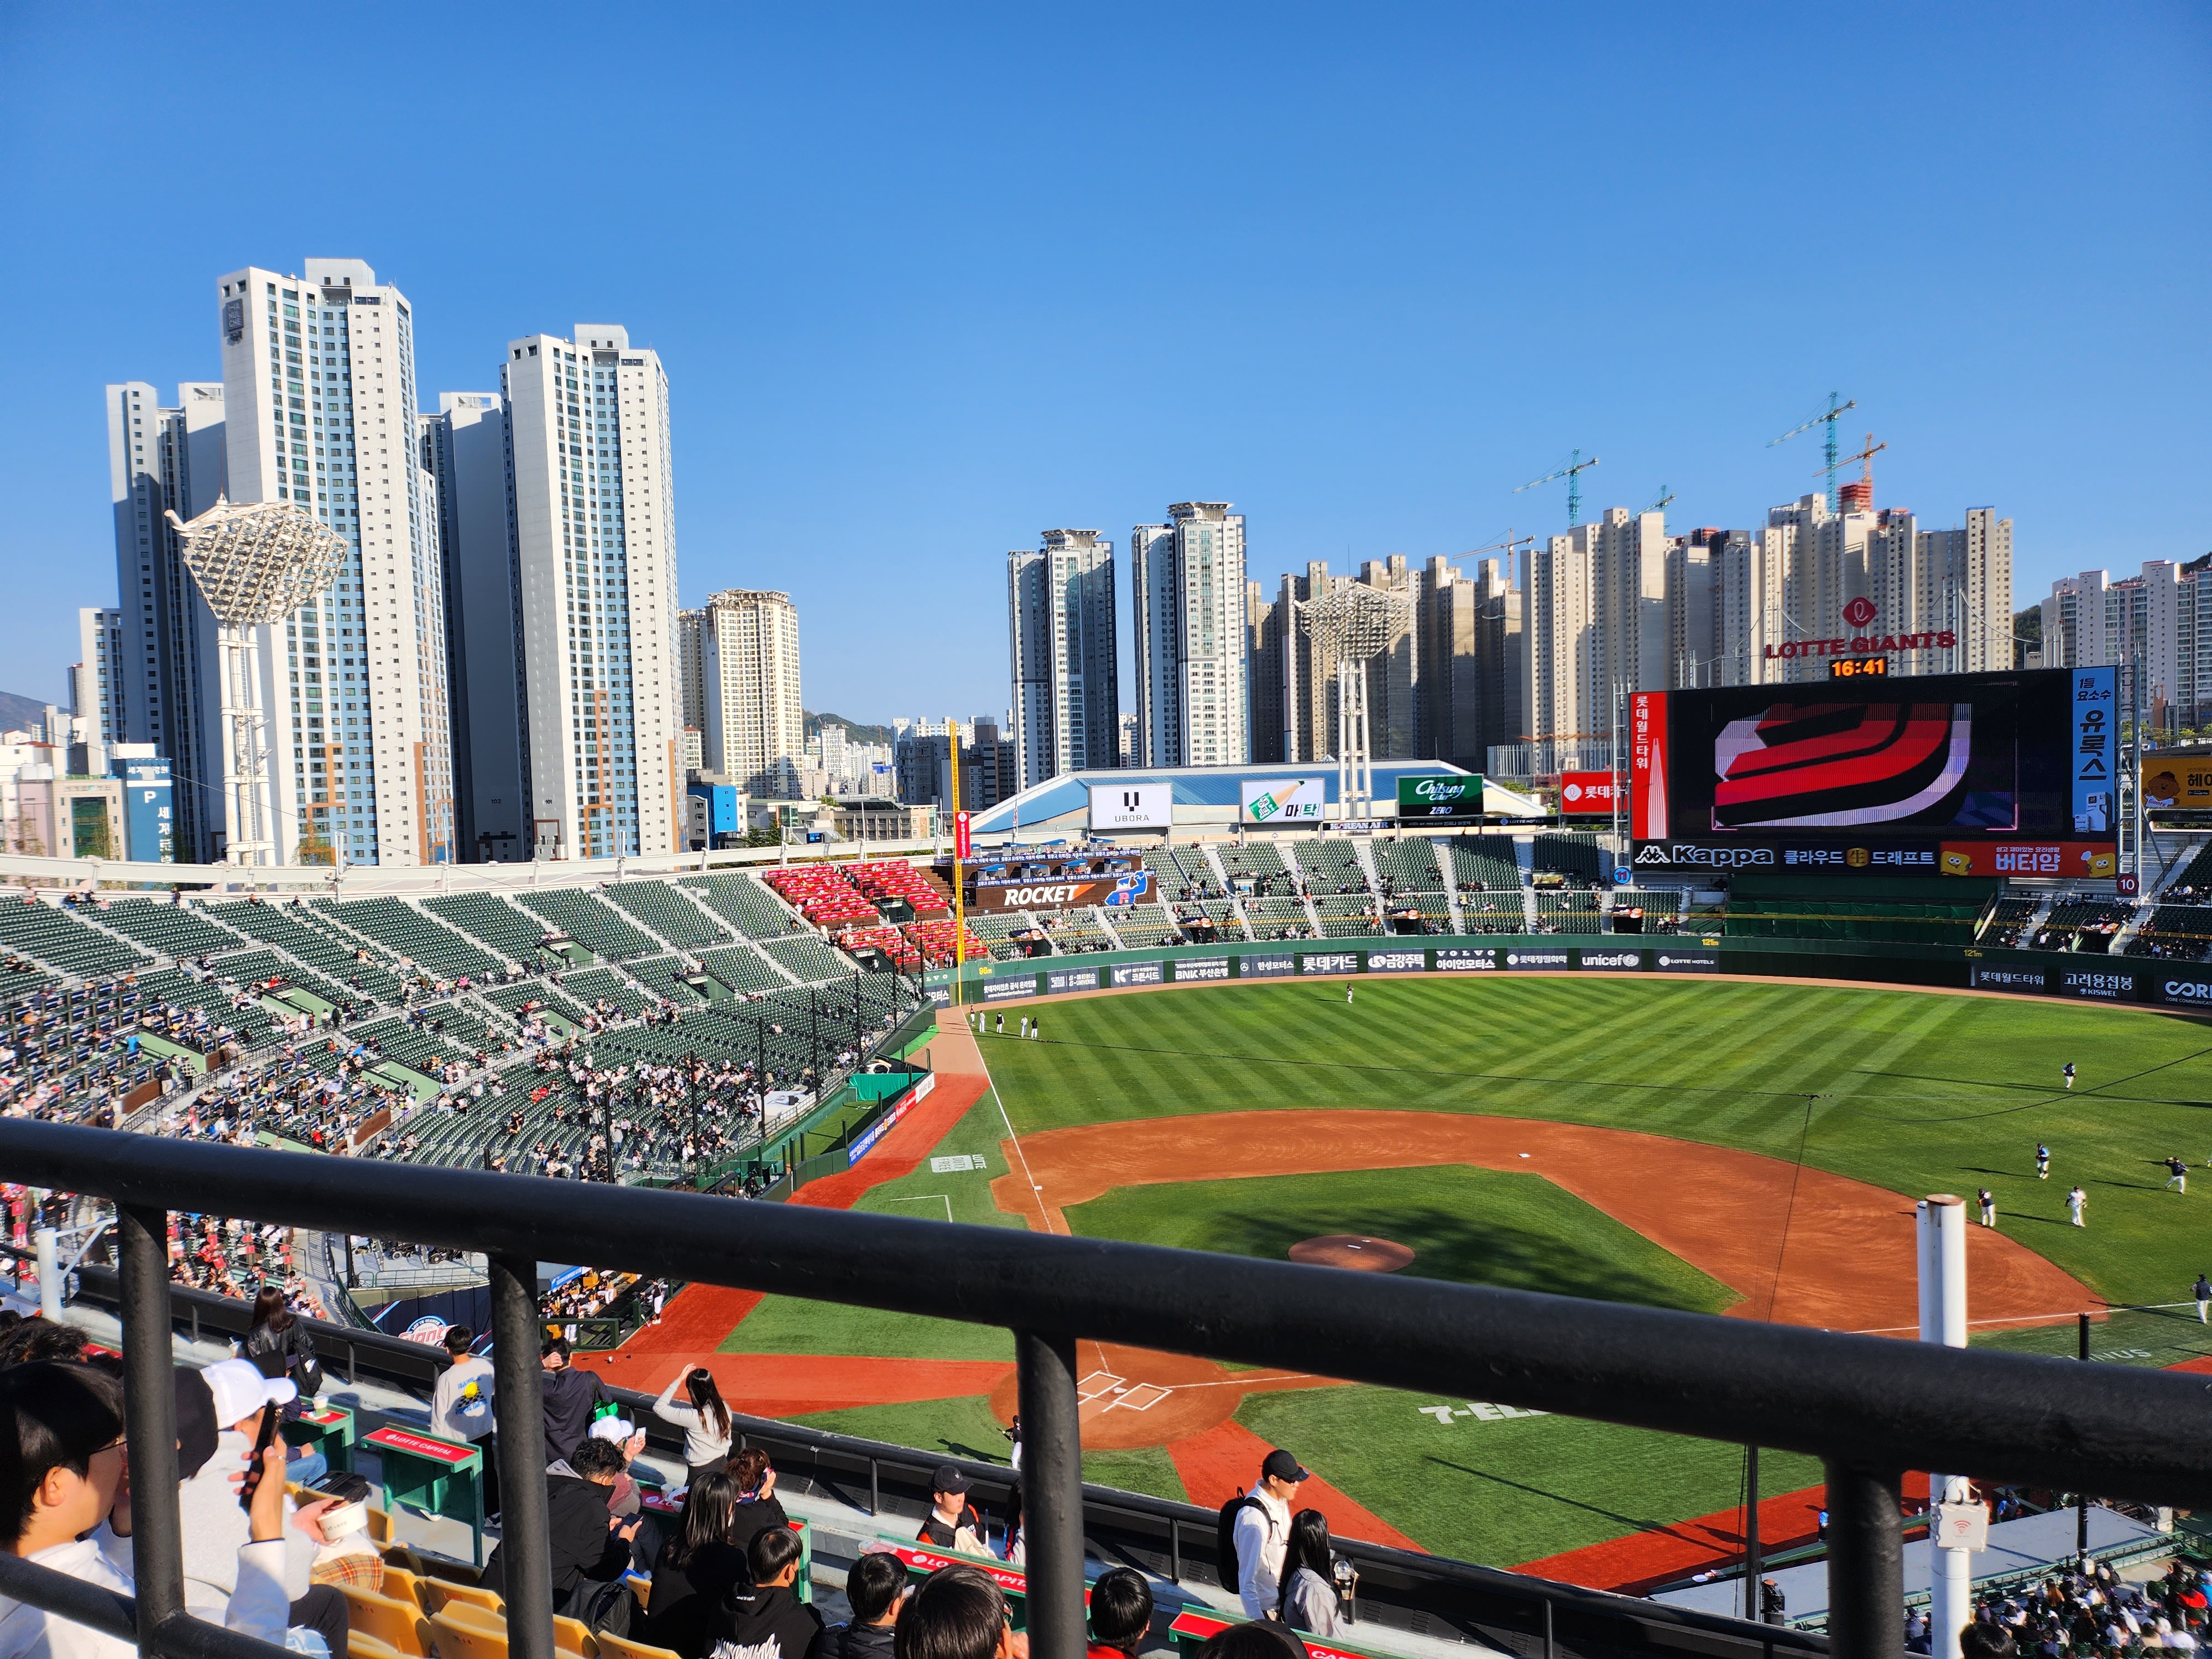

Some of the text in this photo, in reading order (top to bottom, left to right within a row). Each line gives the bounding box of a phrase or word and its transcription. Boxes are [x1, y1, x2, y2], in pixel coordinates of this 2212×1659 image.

[1765, 631, 1956, 659] LOTTE GIANTS
[1832, 659, 1885, 676] 16:41
[2079, 677, 2095, 689] 1등
[2077, 690, 2111, 701] 요소수
[1636, 696, 1648, 769] 롯데월드타워
[2078, 709, 2107, 780] 유록스
[1415, 780, 1465, 799] Chilsung
[1584, 785, 1630, 799] 롯데카
[144, 791, 156, 804] P
[1258, 795, 1270, 817] 생탁
[1429, 806, 1453, 815] ZERO
[1672, 846, 1773, 867] Kappa
[1784, 850, 1844, 865] 클라우드
[1871, 851, 1935, 865] 드래프트
[1996, 853, 2060, 872] 버터얌
[1615, 871, 1627, 881] 11
[2120, 879, 2135, 890] 10
[1004, 885, 1079, 906] ROCKET
[1520, 955, 1567, 964] 롯데정밀화학
[1582, 954, 1623, 966] unicef
[1963, 949, 1983, 958] 121m
[1257, 961, 1294, 971] 한성모터스
[1302, 956, 1358, 971] 롯데카드
[1386, 954, 1425, 968] 금강주택
[1436, 959, 1496, 969] 아이언모터스
[1175, 968, 1228, 979] BNK 부산은행
[1979, 971, 2044, 985] 롯데월드타워
[983, 979, 1037, 993] 롯데자이언츠 공식 온라인몰
[2063, 973, 2133, 991] 고려용접봉
[926, 989, 950, 1001] 모터스
[2088, 988, 2117, 997] KISWEL
[2165, 981, 2212, 999] COR
[938, 1158, 951, 1171] FREE
[972, 1154, 987, 1169] LOTTE
[399, 1325, 451, 1344] Giant
[393, 1436, 452, 1455] LOTTE CAPITAL
[992, 1573, 1026, 1587] APIT
